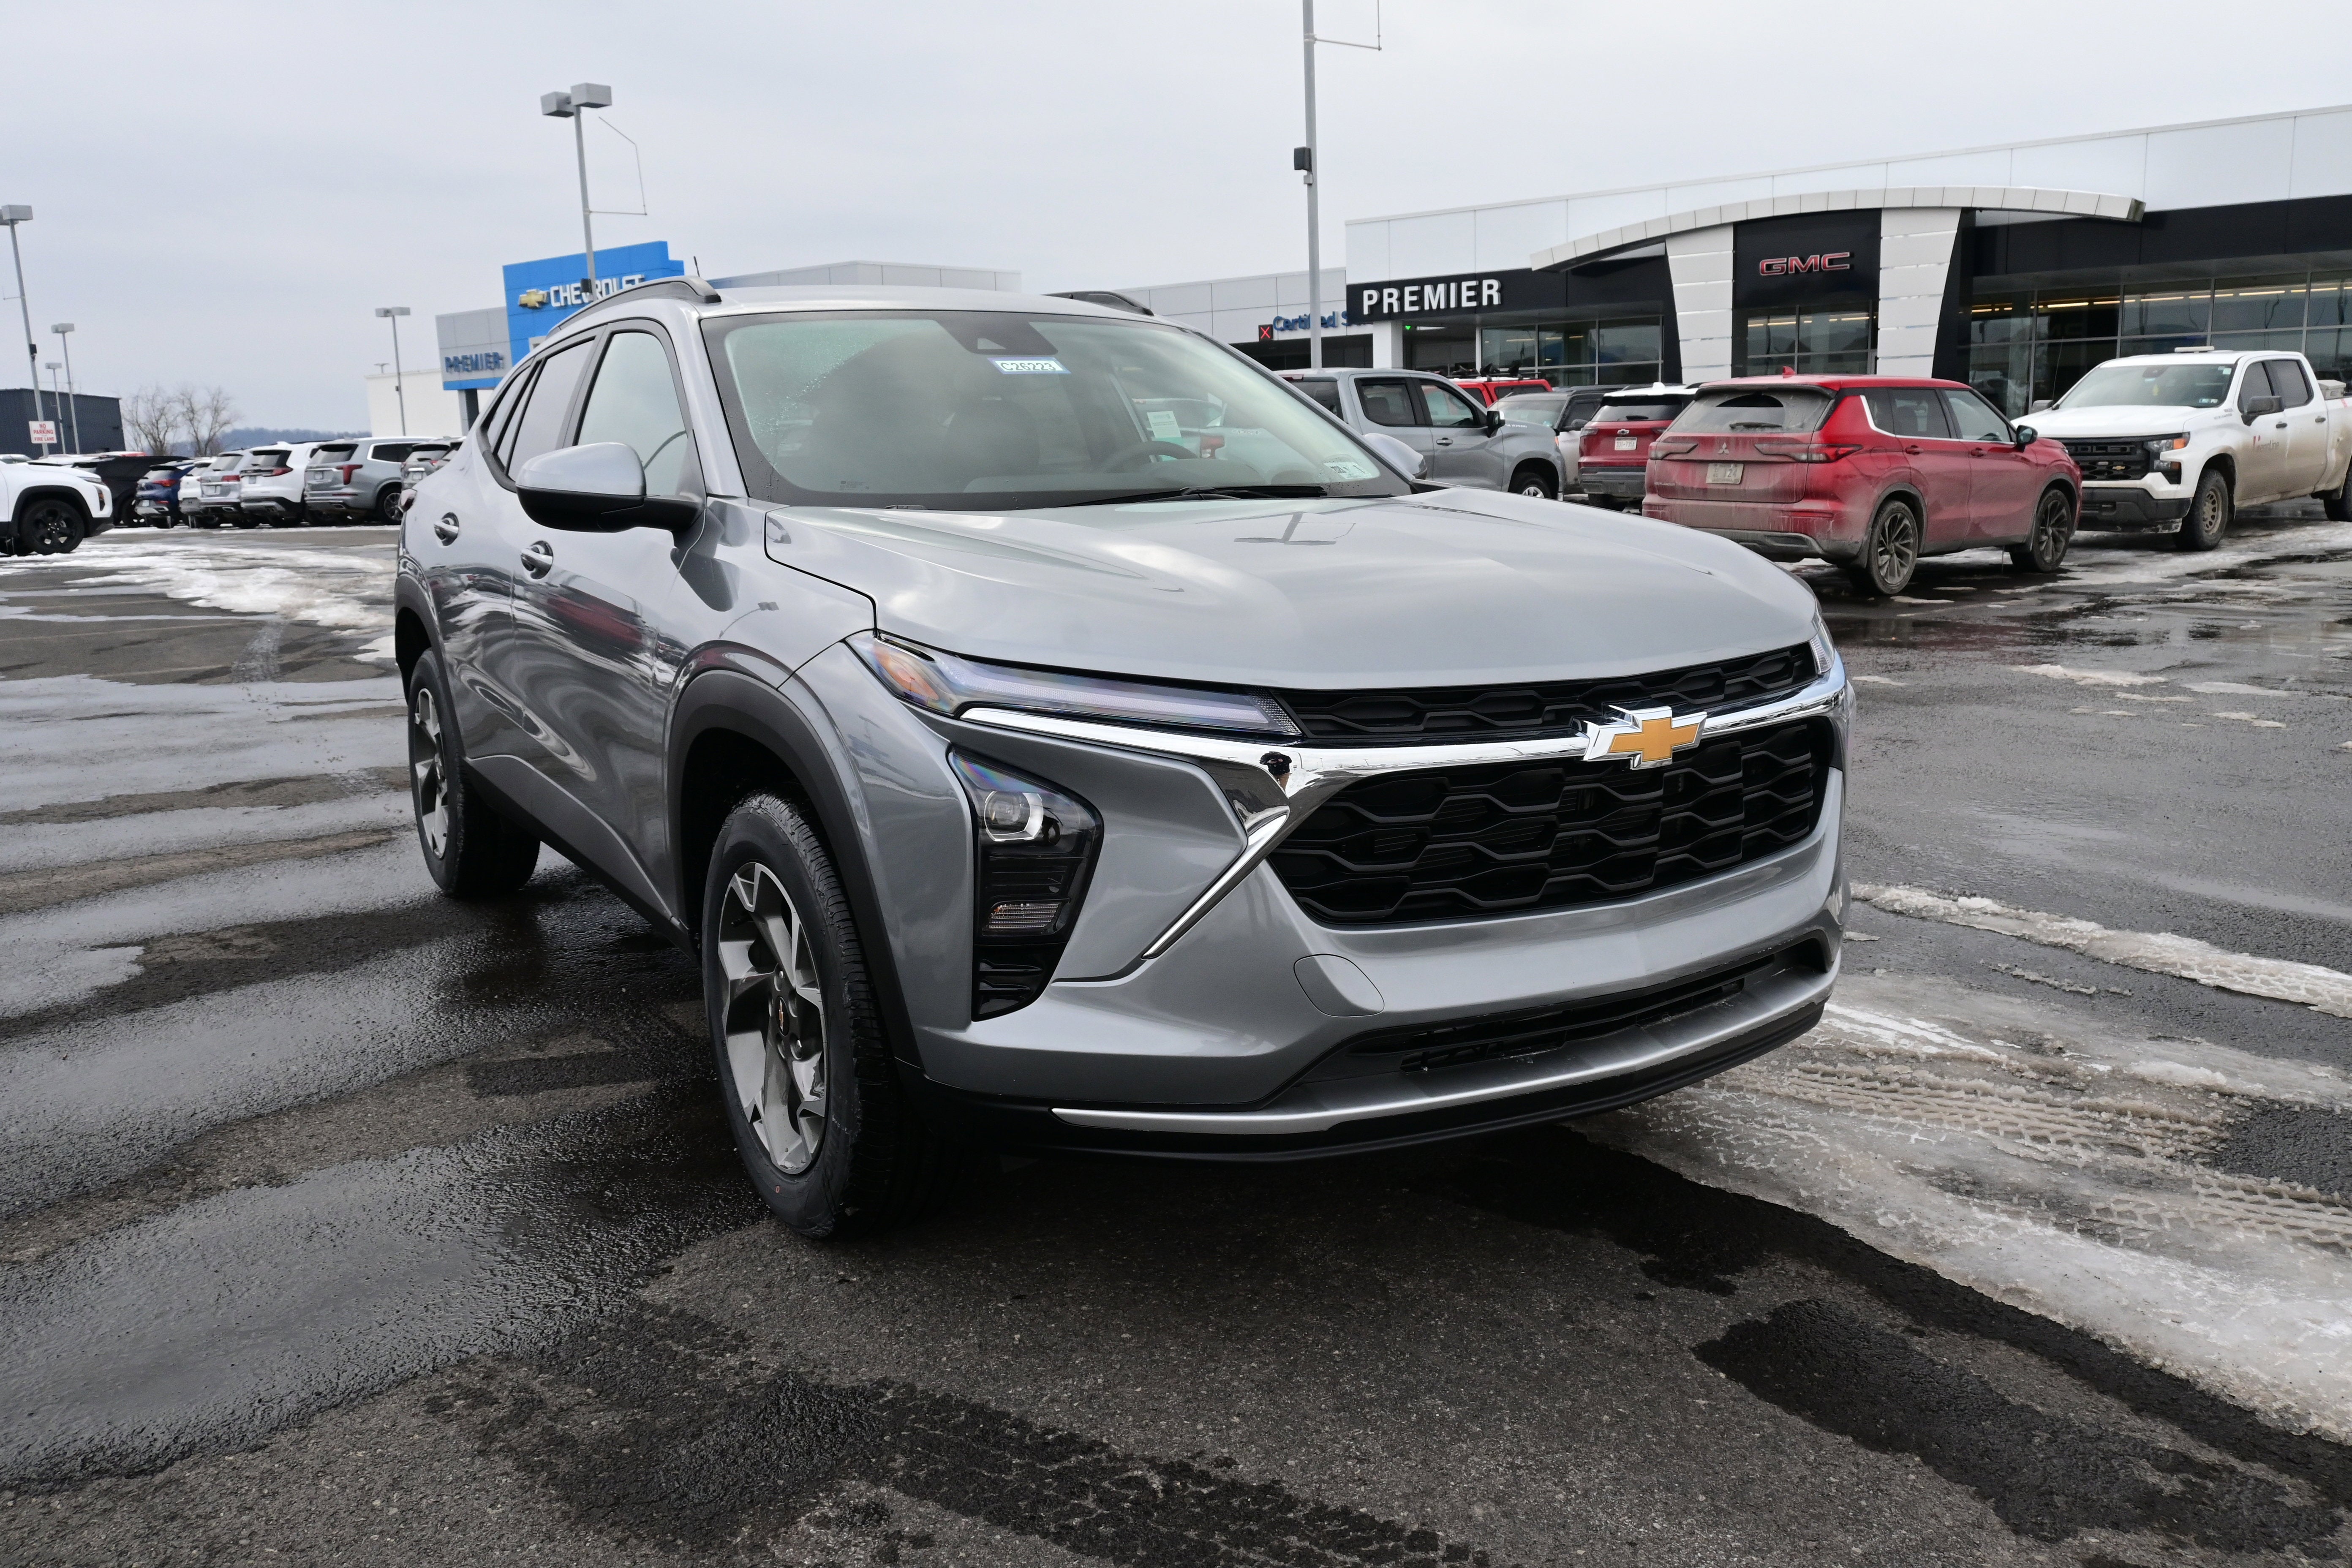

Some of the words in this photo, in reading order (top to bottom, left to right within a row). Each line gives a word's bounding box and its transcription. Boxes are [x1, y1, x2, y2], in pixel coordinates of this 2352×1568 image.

[1759, 252, 1850, 275] GMC
[1363, 279, 1501, 315] PREMIER
[444, 352, 504, 373] PREMIER
[1000, 362, 1056, 370] C26223
